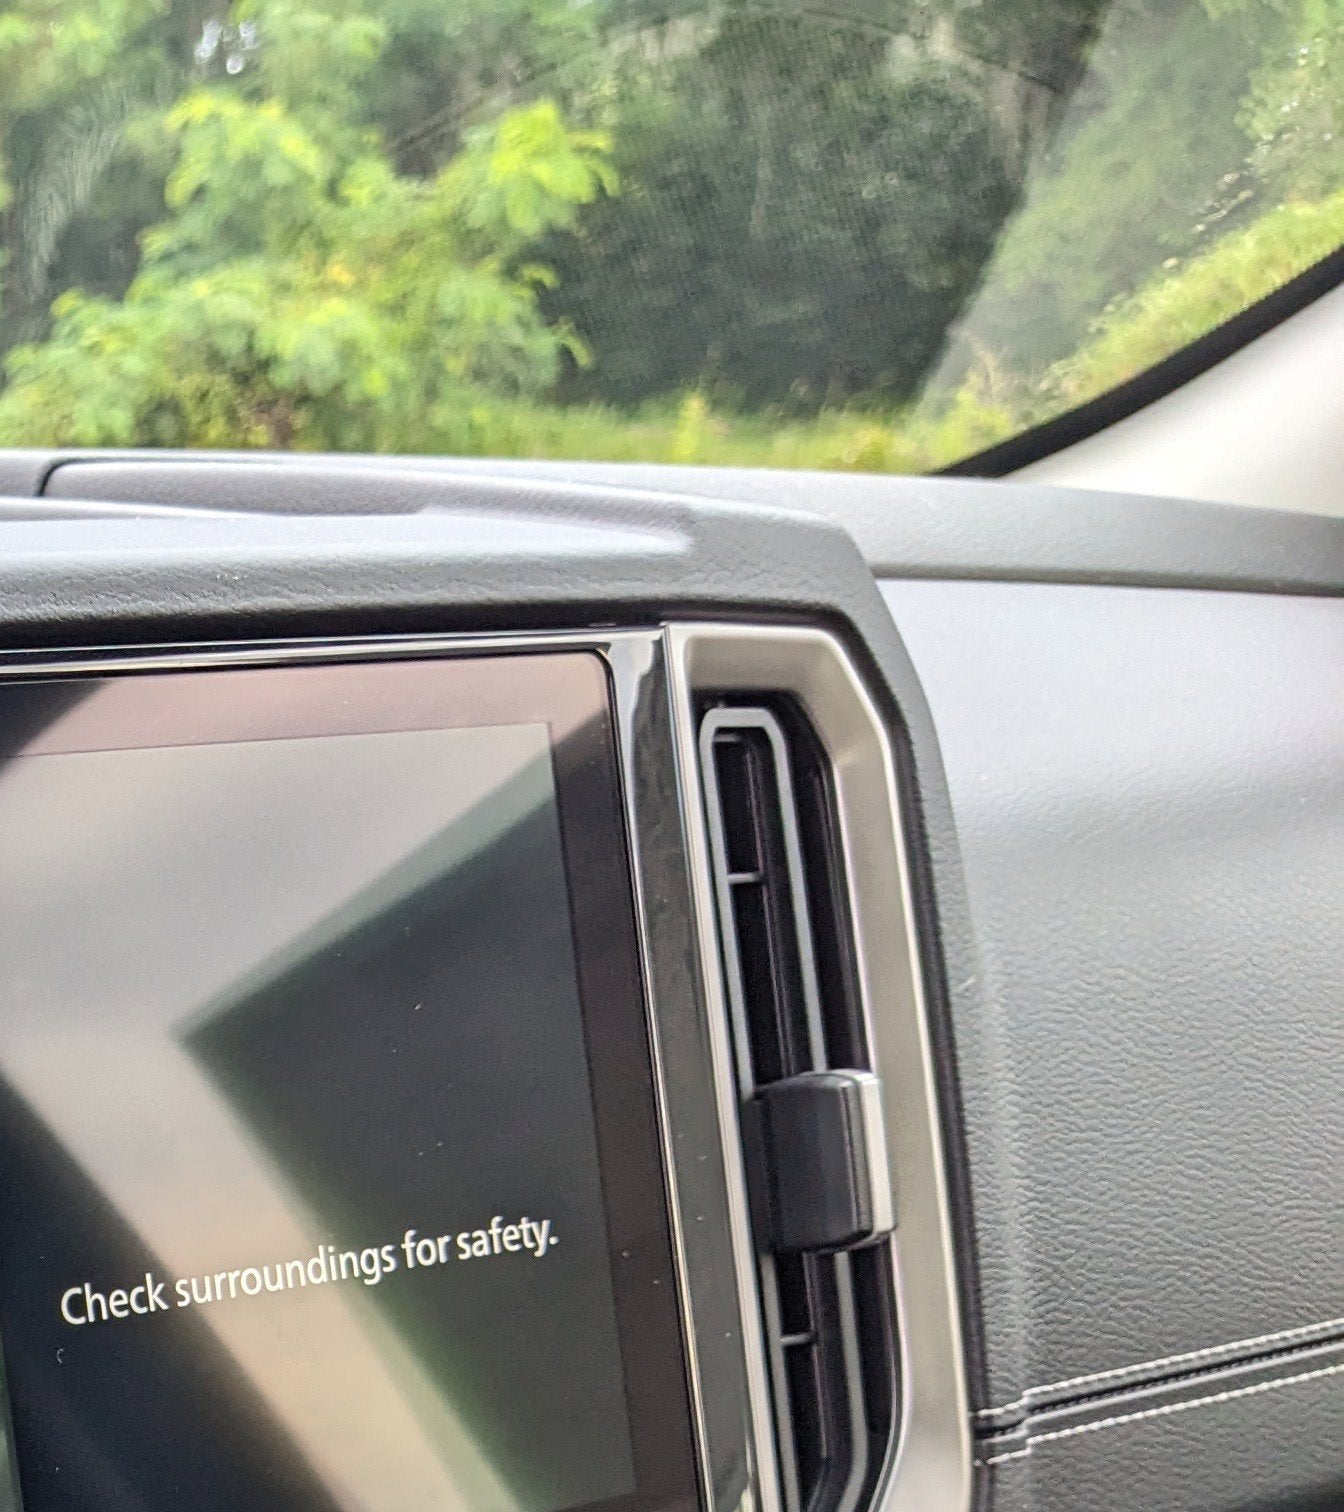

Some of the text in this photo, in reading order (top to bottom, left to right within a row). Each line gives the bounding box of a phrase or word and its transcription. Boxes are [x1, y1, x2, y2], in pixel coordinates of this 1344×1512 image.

[60, 1214, 560, 1325] Check surroundings for safety.
